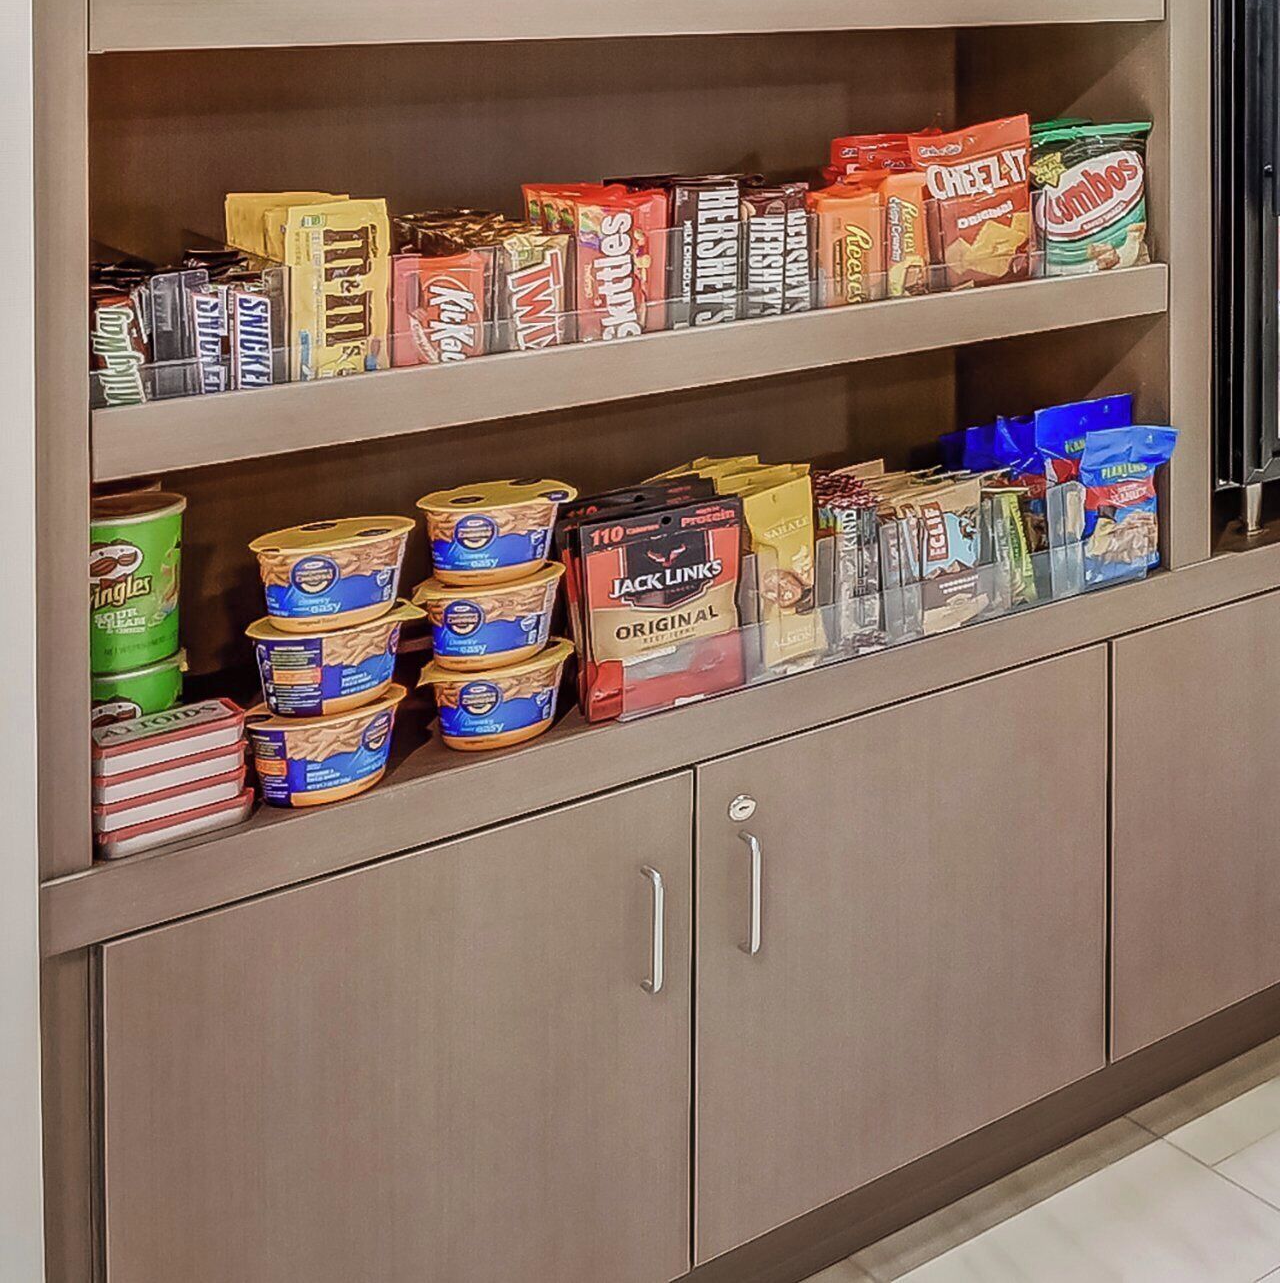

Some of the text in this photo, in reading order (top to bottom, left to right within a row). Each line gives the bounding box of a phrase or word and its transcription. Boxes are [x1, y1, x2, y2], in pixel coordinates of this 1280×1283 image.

[845, 224, 873, 303] Reese's
[593, 211, 642, 341] skittles
[681, 509, 735, 528] Protein
[589, 525, 625, 547] 110
[843, 510, 857, 551] KIND
[470, 557, 499, 568] easy
[609, 571, 663, 599] JACK
[308, 601, 342, 614] easy
[615, 604, 720, 641] ORIGINAL
[460, 643, 488, 655] easy
[475, 723, 504, 734] easy
